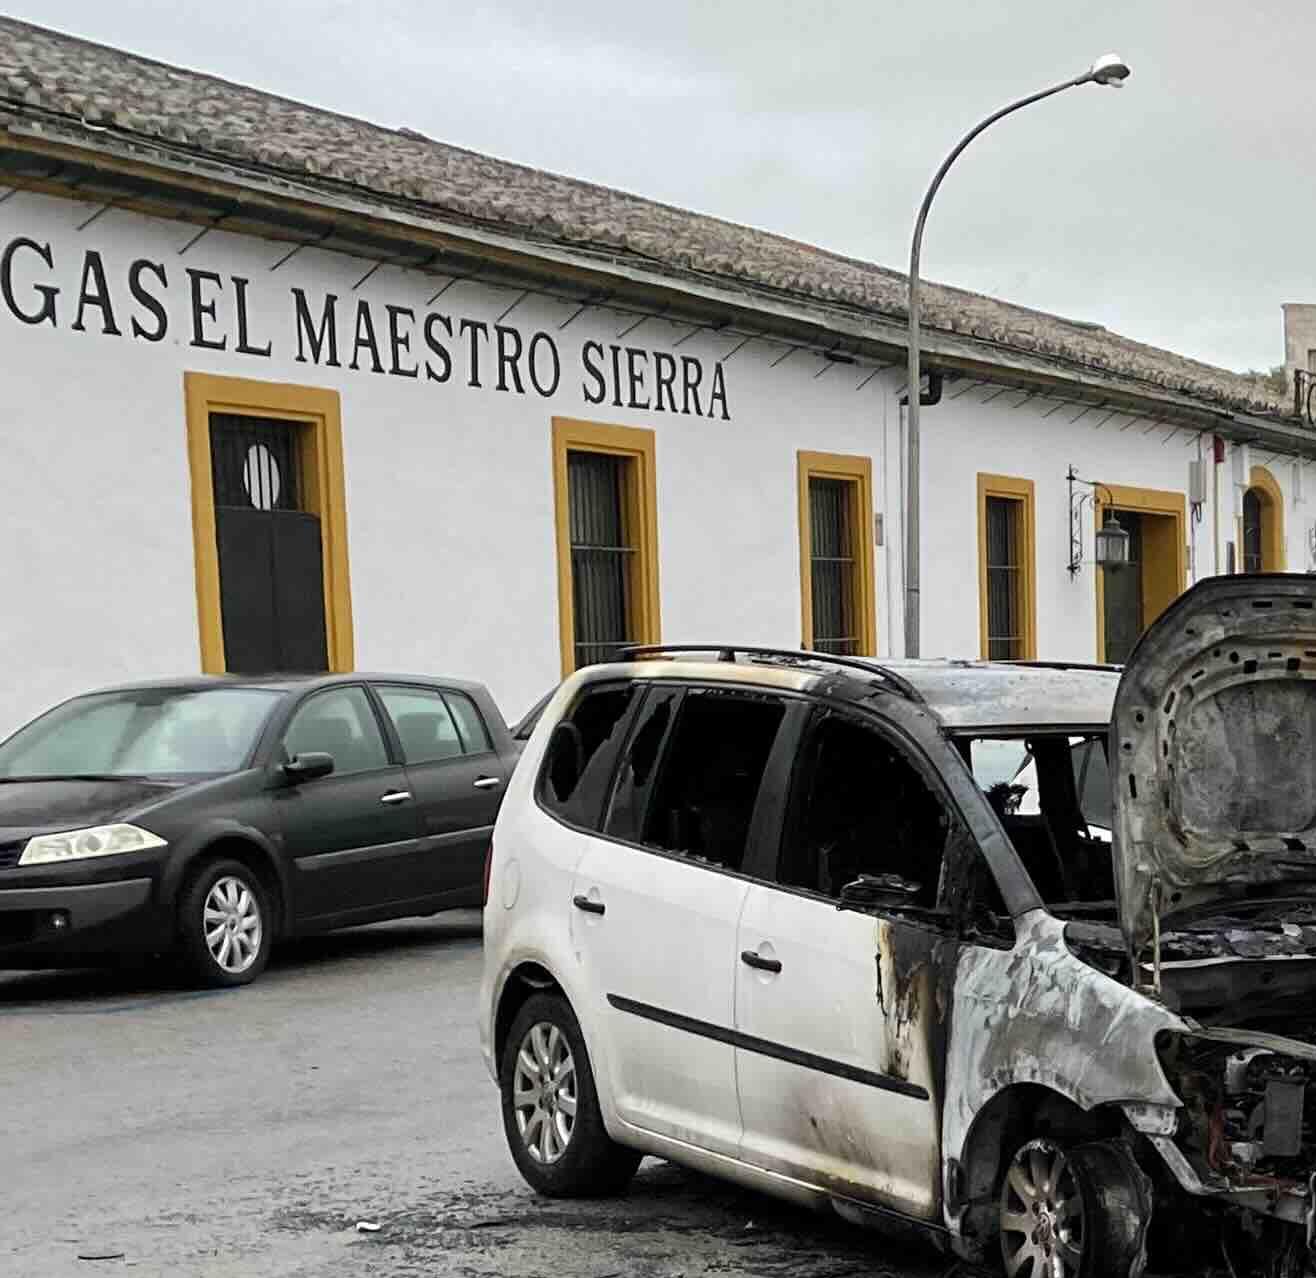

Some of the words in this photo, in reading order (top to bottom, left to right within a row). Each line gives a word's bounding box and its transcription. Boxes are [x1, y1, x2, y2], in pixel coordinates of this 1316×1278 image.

[185, 268, 272, 357] EL
[291, 288, 560, 397] MAESTRO
[582, 340, 731, 421] SIERRA
